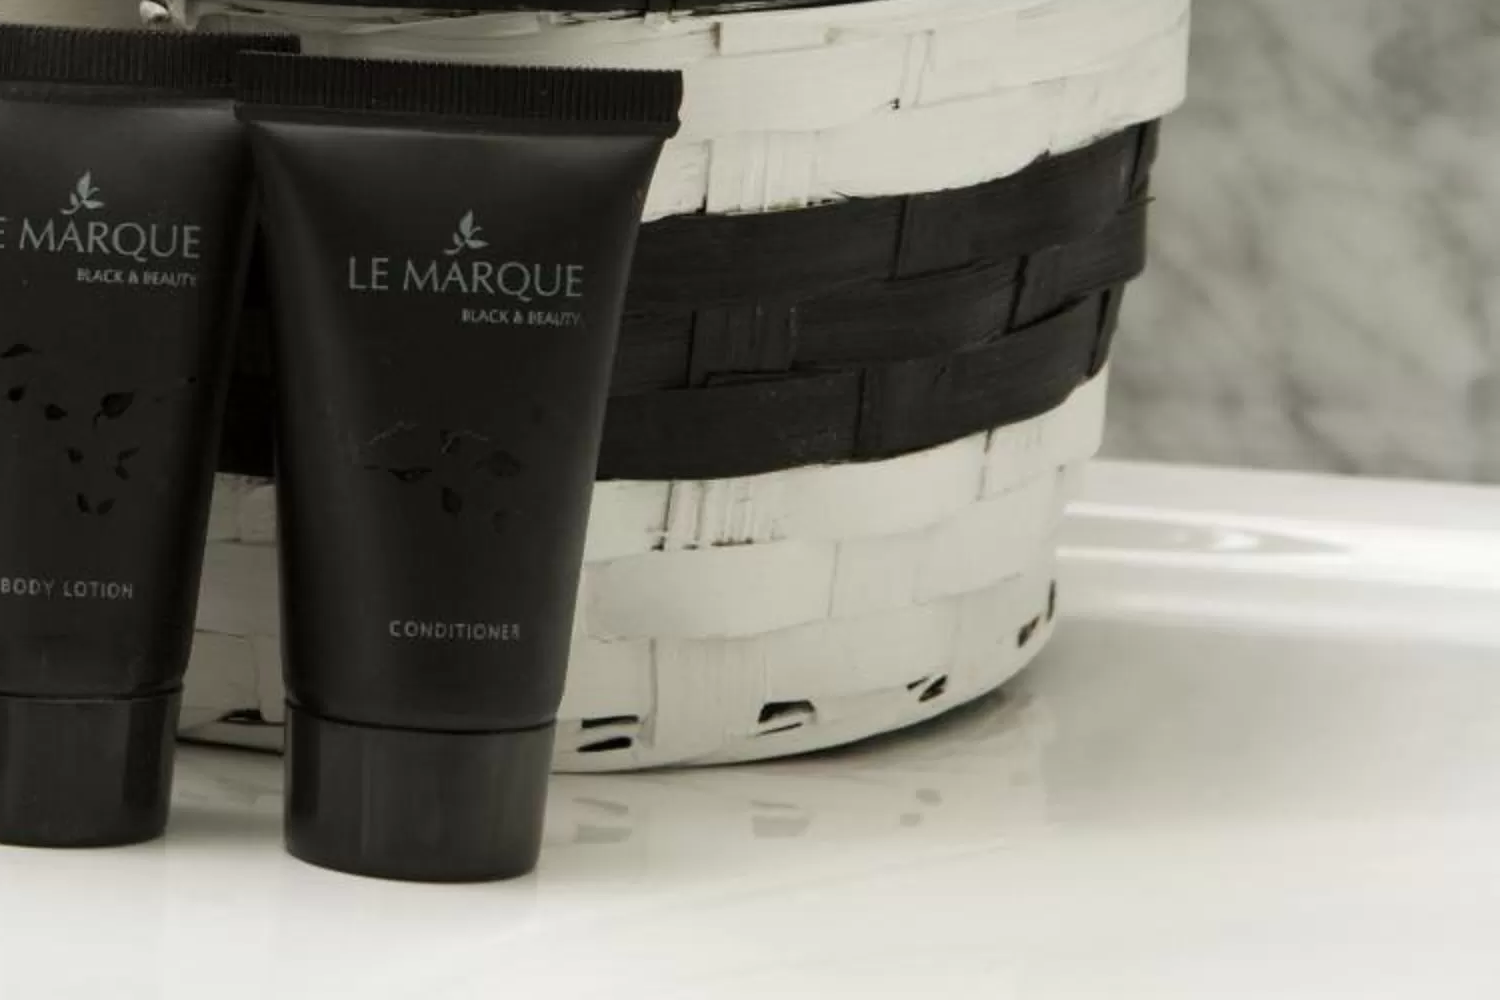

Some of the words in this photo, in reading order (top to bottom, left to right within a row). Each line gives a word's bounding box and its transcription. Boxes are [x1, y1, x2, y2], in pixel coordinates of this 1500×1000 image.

[19, 217, 201, 262] MARQUE
[76, 267, 124, 284] BLACK
[143, 270, 197, 288] BEAUTY
[348, 256, 389, 291] LE
[403, 259, 585, 303] MARQUE
[461, 307, 508, 324] BLACK
[528, 309, 581, 327] BEAUTY
[0, 576, 54, 597] BODY
[63, 580, 134, 600] LOTION
[388, 619, 521, 641] CONDITIONER
